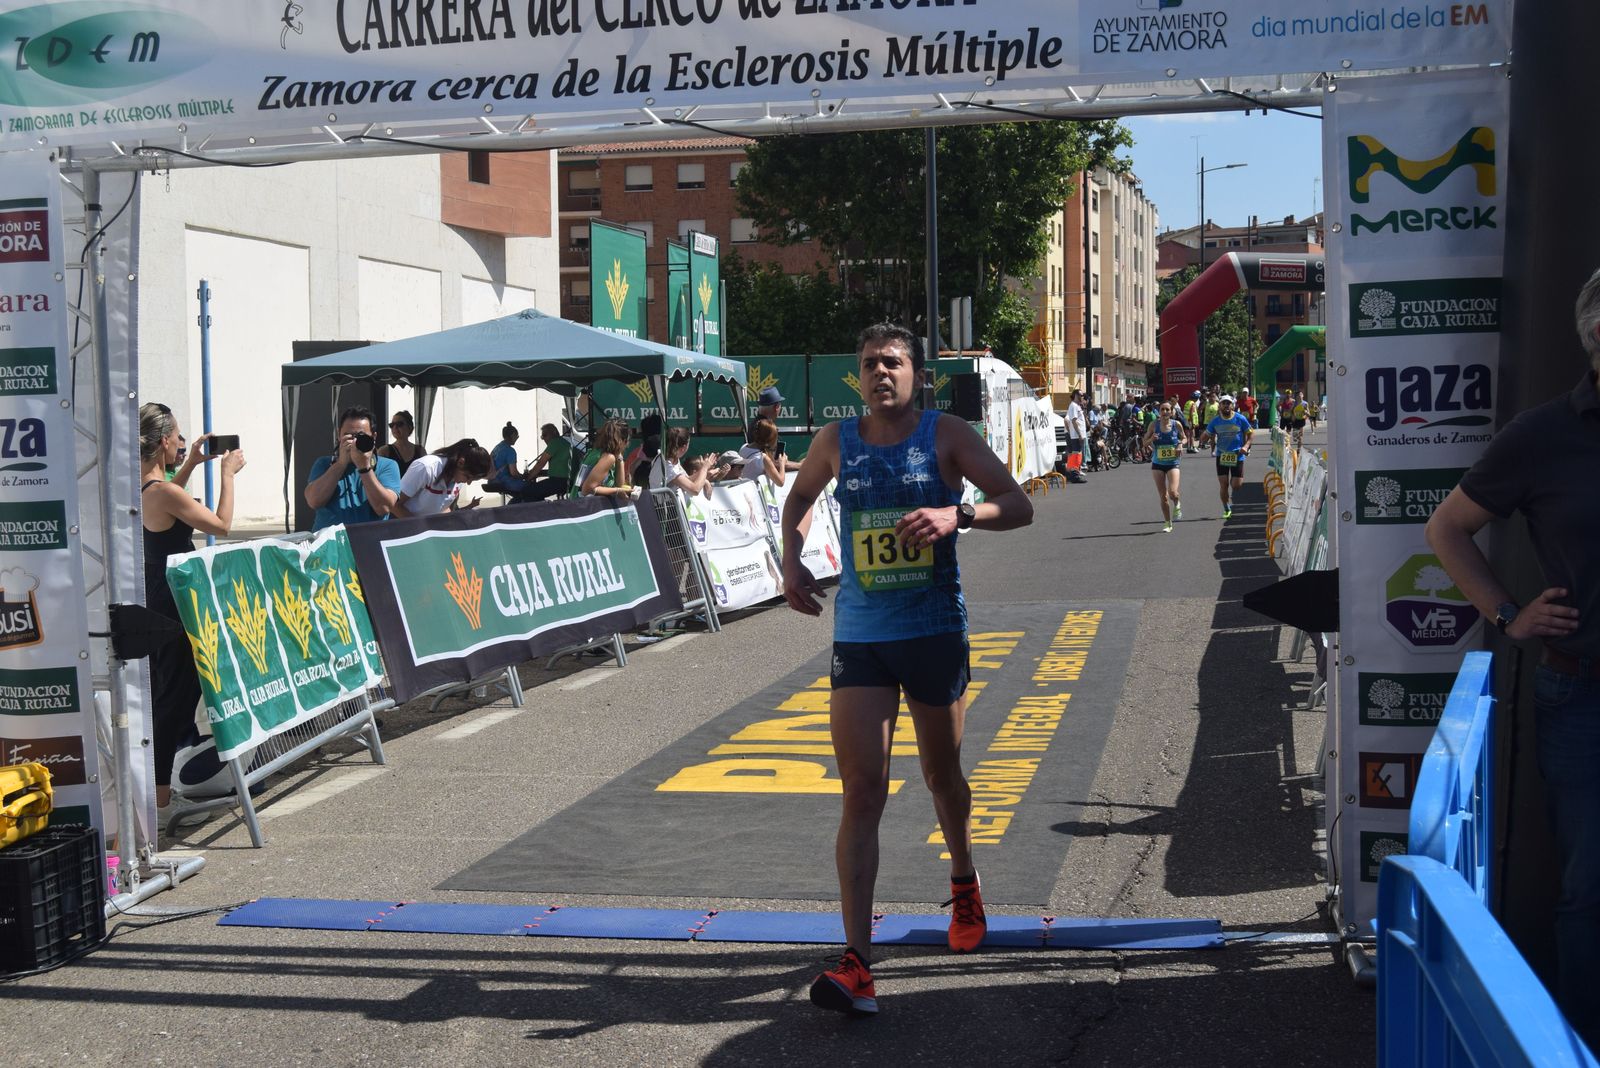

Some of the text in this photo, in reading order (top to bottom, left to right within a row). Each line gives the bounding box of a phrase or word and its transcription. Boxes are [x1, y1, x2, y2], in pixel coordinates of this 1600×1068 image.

[1094, 11, 1227, 33] AYUNTAMIENTO
[1292, 7, 1385, 36] mundial
[1391, 6, 1421, 29] de
[1425, 5, 1445, 27] la
[1451, 3, 1489, 26] EM
[1093, 29, 1228, 54] DE ZAMORA
[257, 27, 1063, 110] Zamora cerca de la Esclerosis Múltiple
[9, 112, 74, 132] ZAMORANA
[80, 111, 97, 126] DE
[103, 103, 171, 123] ESCLEROSIS
[177, 98, 235, 117] MÚLTIPLE
[25, 221, 41, 232] DE
[1270, 271, 1303, 280] ZAMORA
[1400, 298, 1497, 314] FUNDACION
[1401, 312, 1497, 329] CAJA RURAL
[5, 377, 49, 390] RURAL
[1365, 364, 1492, 431] gaza
[823, 406, 857, 419] CAJA
[1367, 431, 1492, 447] Ganaderos de Zamora
[1161, 448, 1172, 457] 83
[2, 475, 49, 487] de Zamora
[14, 532, 60, 545] RURAL
[490, 547, 625, 617] CAJA RURAL
[875, 572, 928, 584] CAJA RURAL
[24, 696, 72, 711] RURAL
[986, 692, 1073, 752] INTEGRAL
